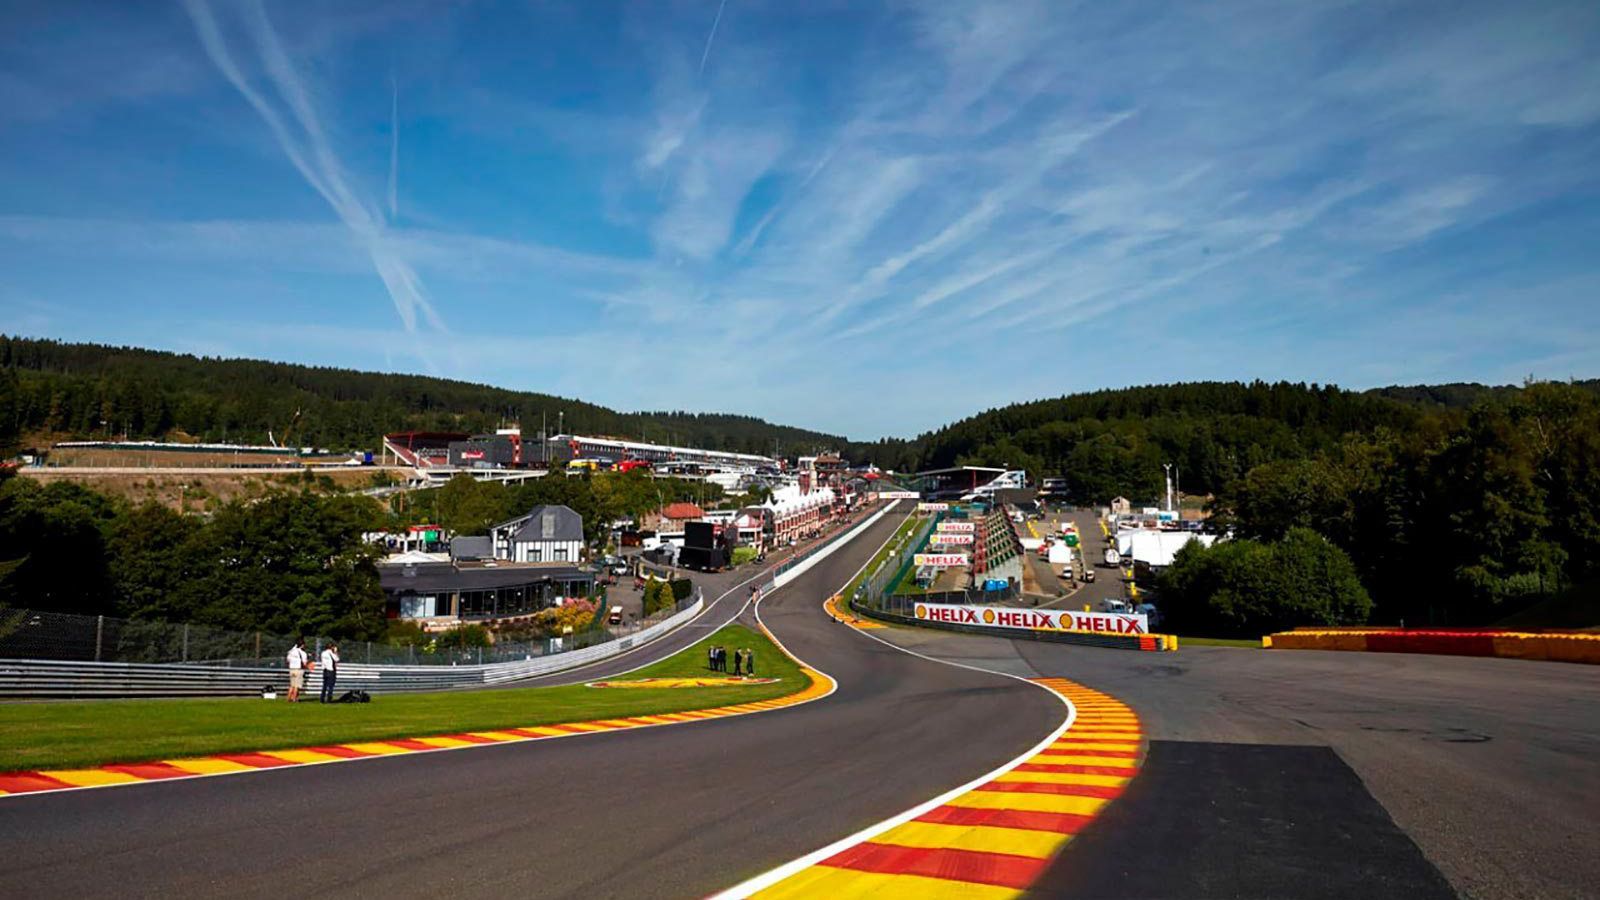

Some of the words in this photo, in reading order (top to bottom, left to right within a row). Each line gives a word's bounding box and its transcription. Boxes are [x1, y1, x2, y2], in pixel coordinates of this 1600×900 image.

[940, 536, 970, 544] HELIX
[926, 556, 965, 564] HELIX
[929, 606, 980, 624] HELIX
[998, 610, 1056, 629] HELIX
[1076, 614, 1145, 634] HELIX
